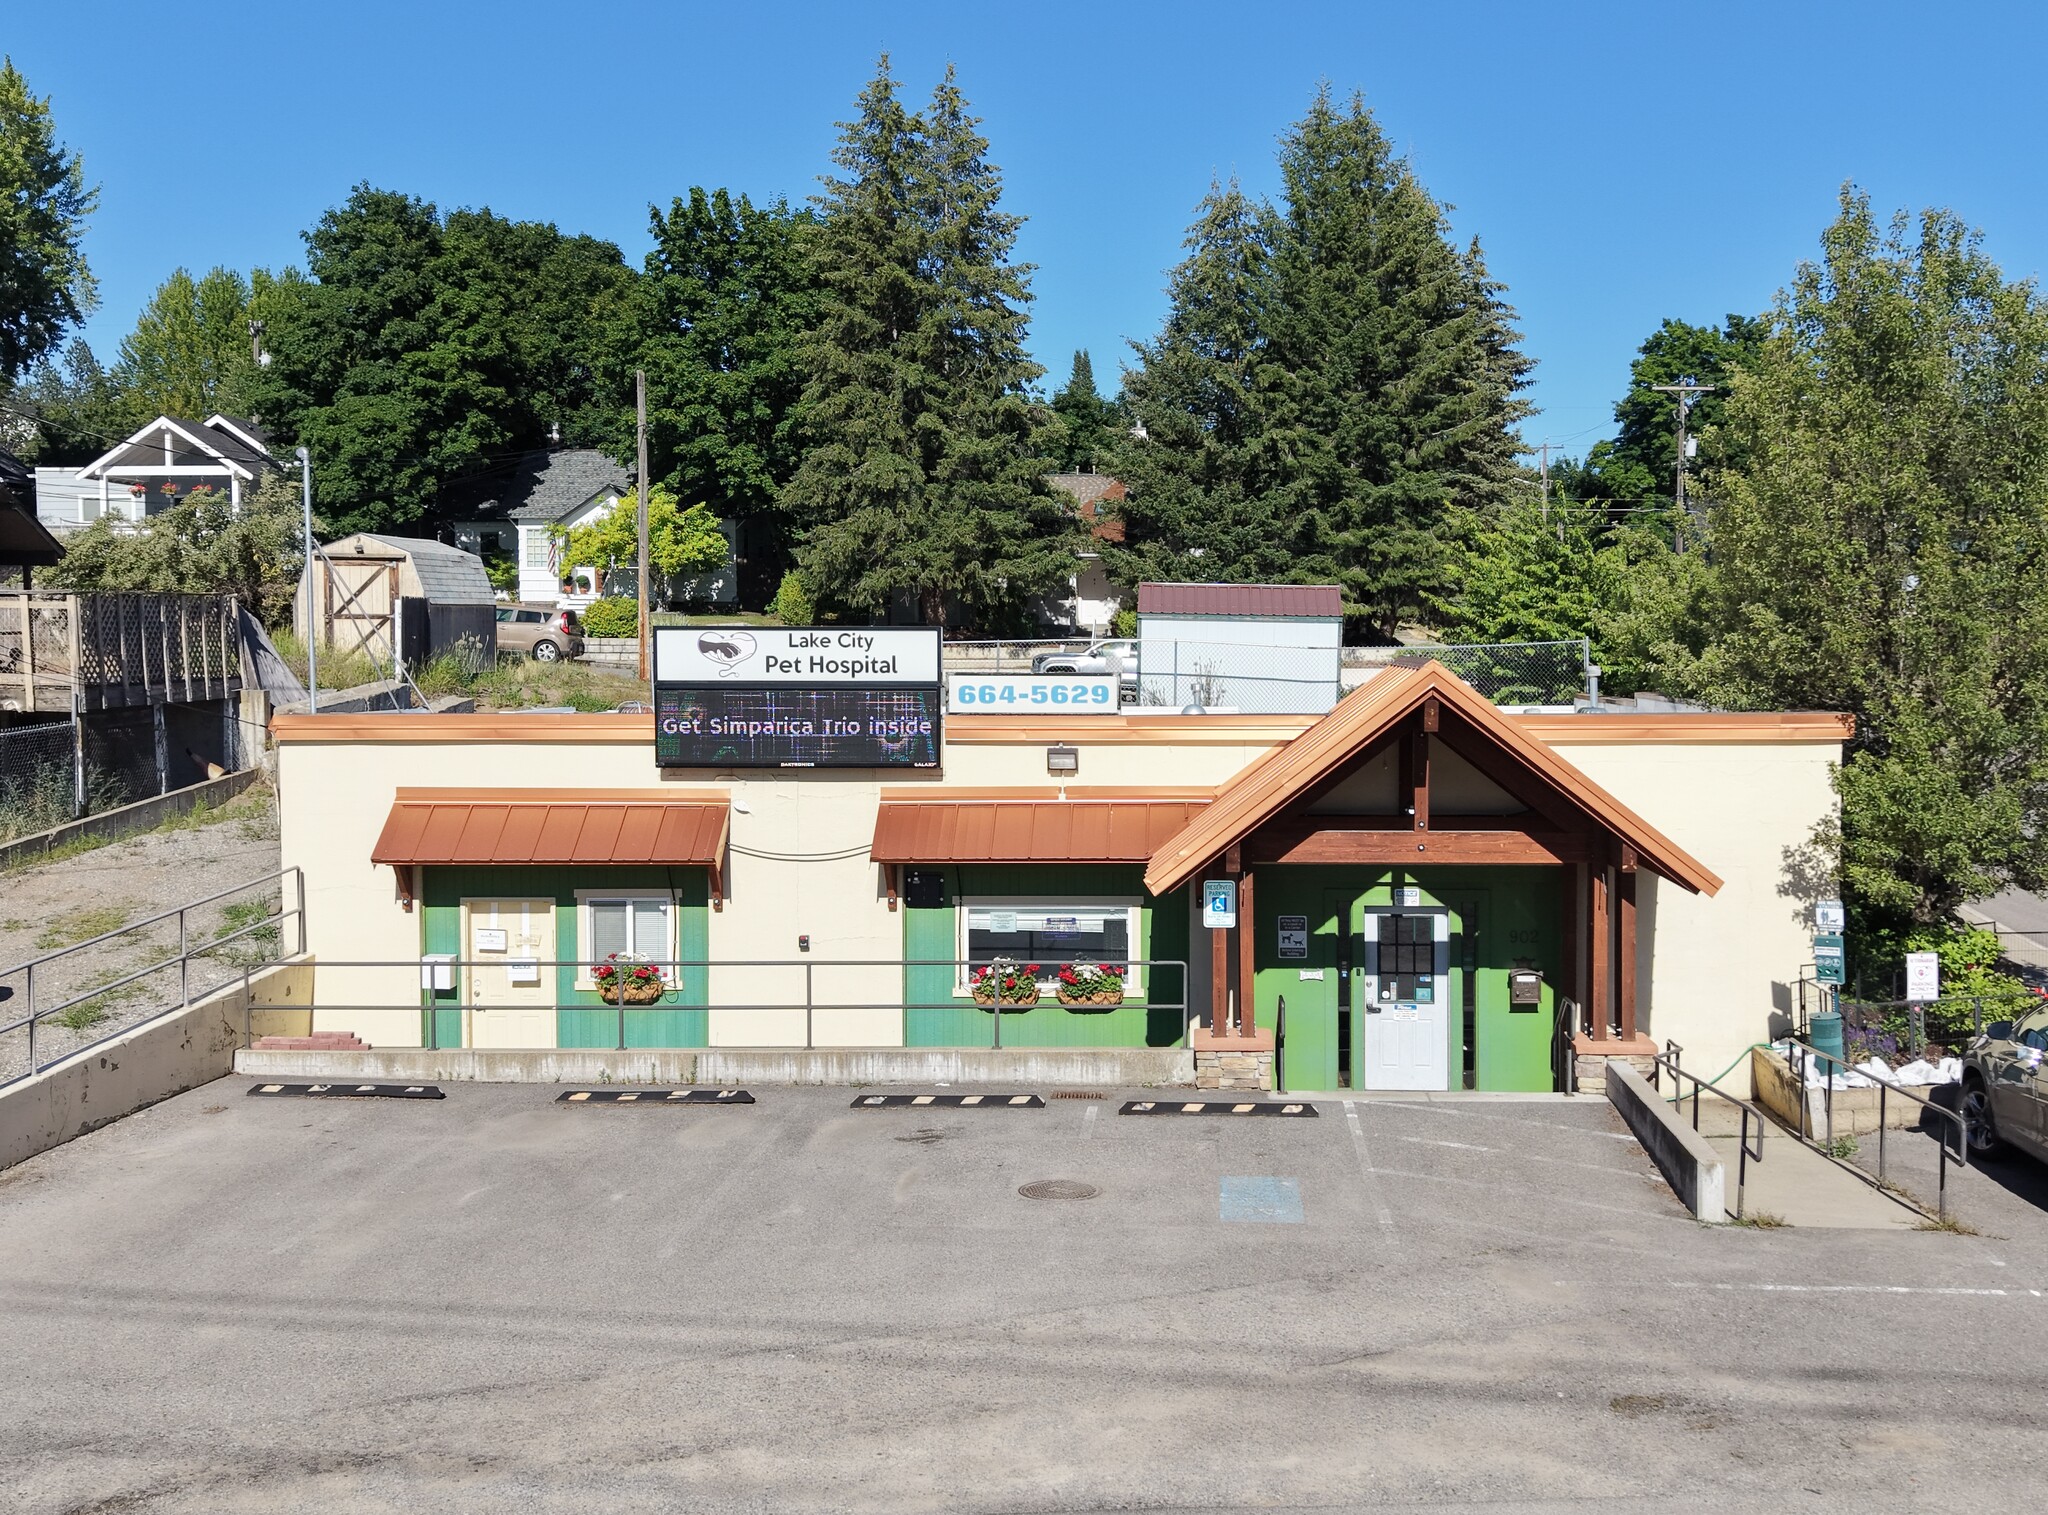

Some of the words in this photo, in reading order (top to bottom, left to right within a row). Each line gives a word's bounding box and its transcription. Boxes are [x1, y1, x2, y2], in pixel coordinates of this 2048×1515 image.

[788, 632, 832, 649] Lake
[837, 632, 874, 652] City
[765, 655, 802, 674] Pet
[810, 655, 898, 678] Hospital
[958, 684, 1110, 705] 664-5629
[662, 718, 702, 735] Get
[710, 715, 813, 738] Simparica
[822, 715, 861, 735] Trio
[869, 715, 932, 735] inside
[1510, 930, 1539, 943] 902
